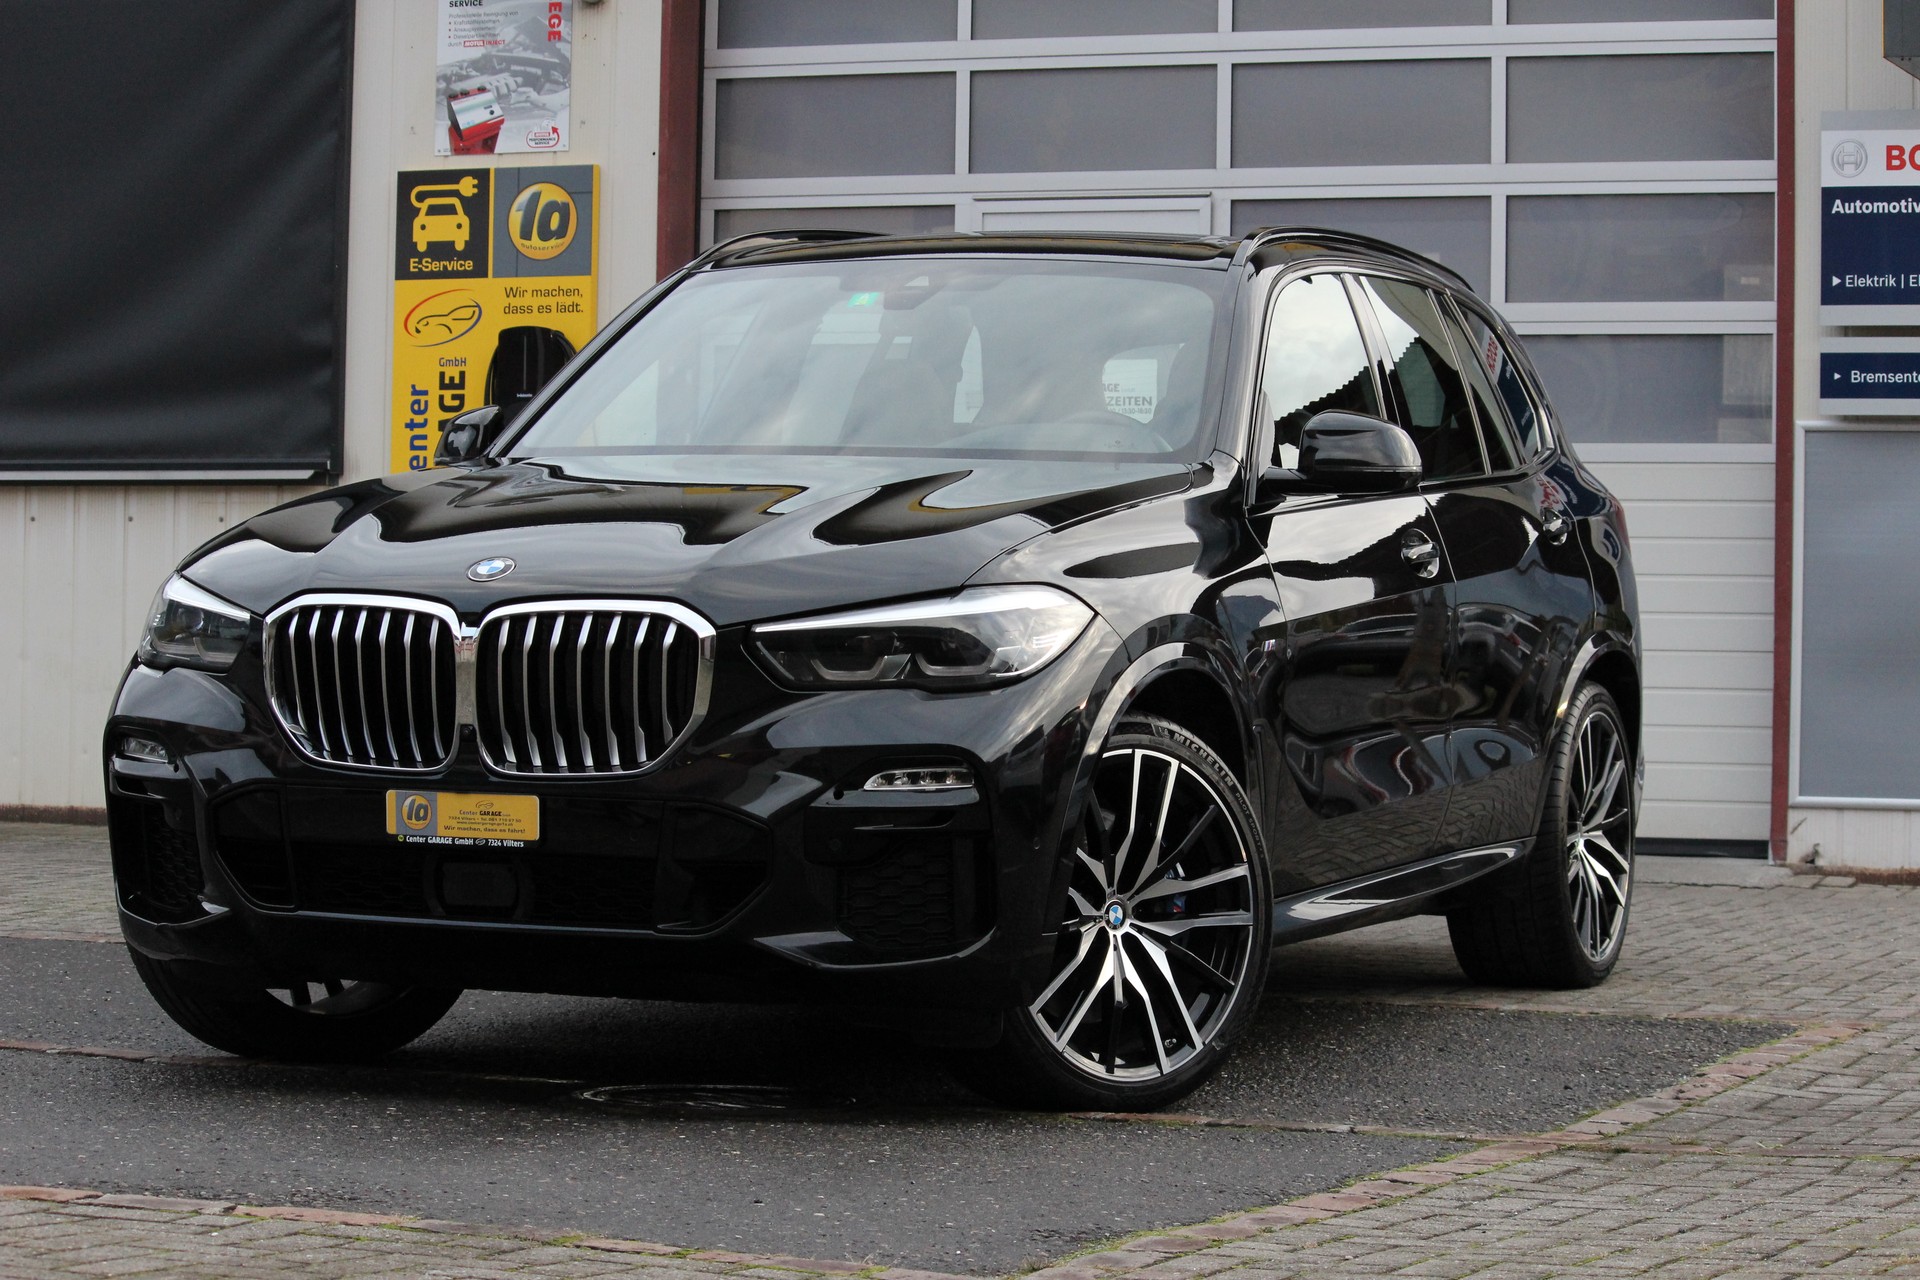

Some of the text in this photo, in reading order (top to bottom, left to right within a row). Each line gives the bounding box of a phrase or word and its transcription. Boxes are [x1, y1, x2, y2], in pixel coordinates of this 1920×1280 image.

[449, 0, 484, 8] SERVICE
[547, 2, 563, 42] EGE
[409, 257, 474, 272] E-Service
[1845, 274, 1897, 287] Elektrik
[504, 286, 583, 299] Wir machen,
[503, 301, 584, 315] dass es lädt.
[438, 356, 467, 367] GmbH
[1850, 370, 1920, 384] Bremsent
[1106, 396, 1153, 407] ZEITEN
[404, 384, 429, 471] enter
[1173, 733, 1235, 788] MICHELIN
[1235, 792, 1250, 816] PILOT
[406, 835, 425, 843] Center
[427, 836, 452, 844] GARAGE
[454, 837, 474, 845] GmbH
[503, 839, 524, 848] Vilters
